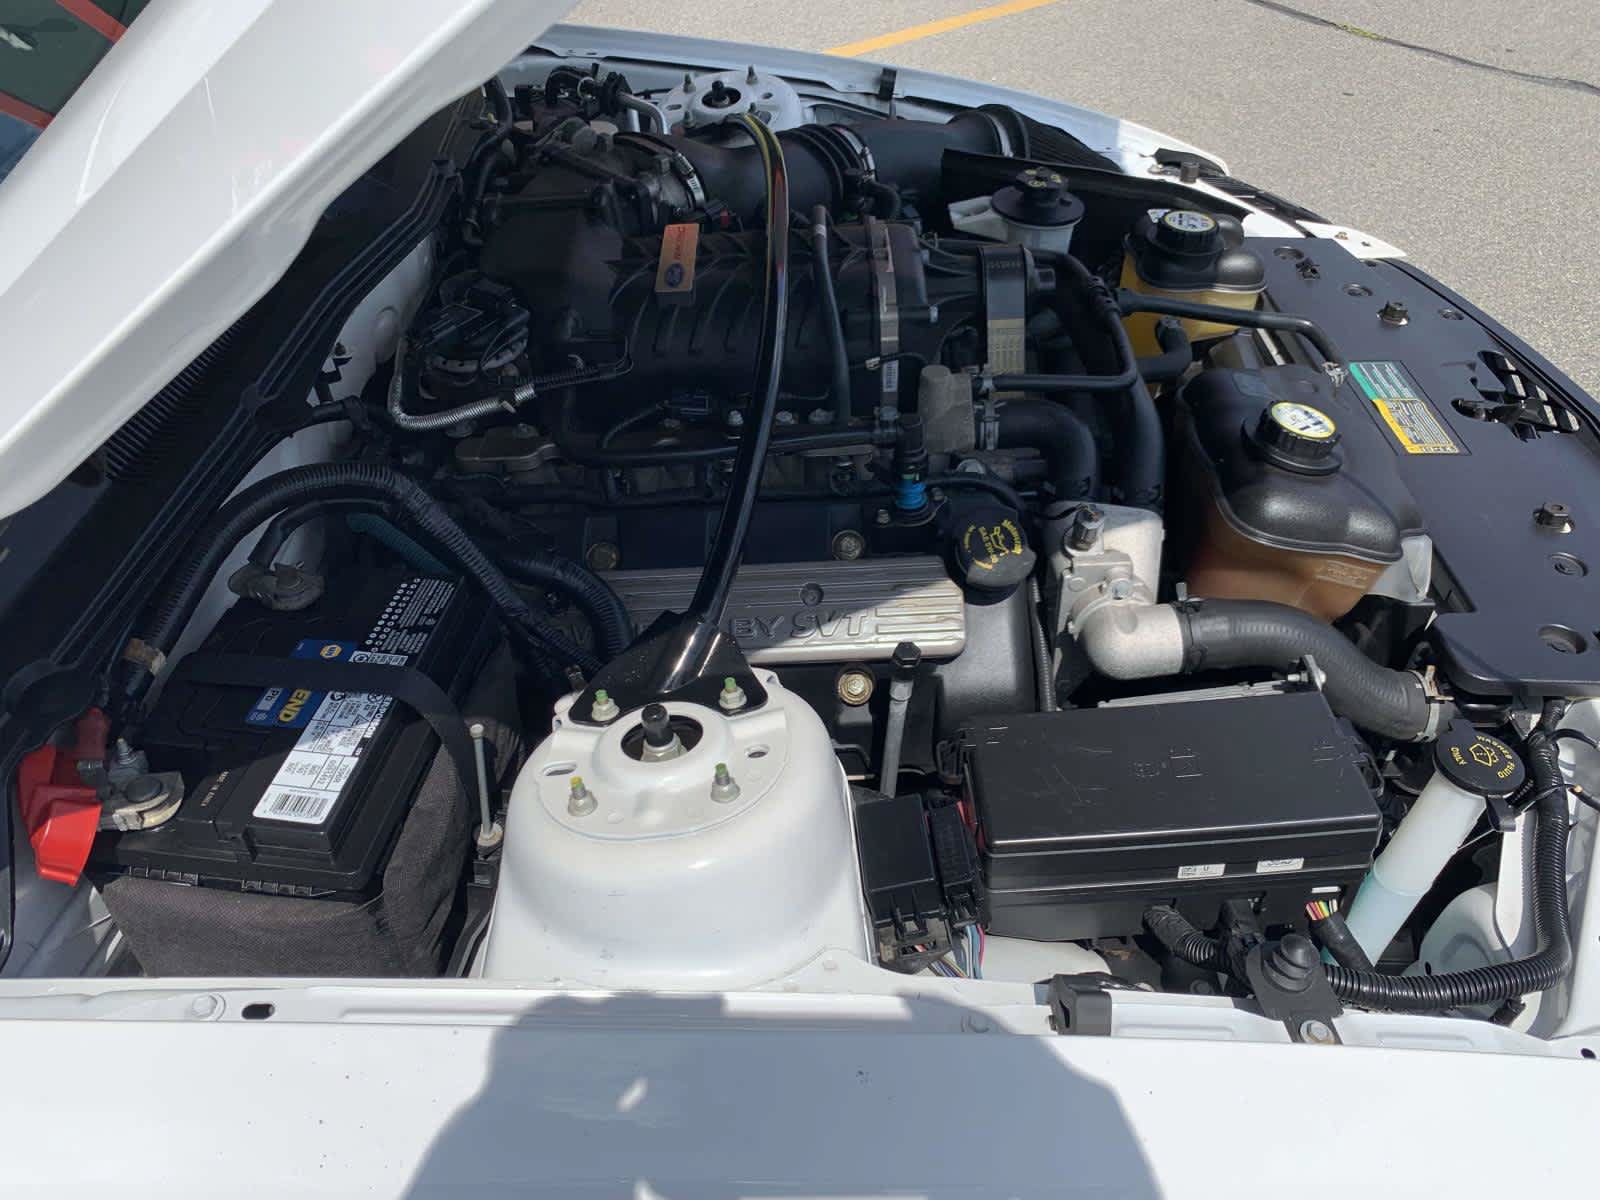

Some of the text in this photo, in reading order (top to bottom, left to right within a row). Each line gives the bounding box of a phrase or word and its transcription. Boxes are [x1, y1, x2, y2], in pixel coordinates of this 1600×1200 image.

[731, 609, 869, 639] BY SVT
[1450, 747, 1468, 766] ONLY
[1497, 761, 1516, 779] FLUID
